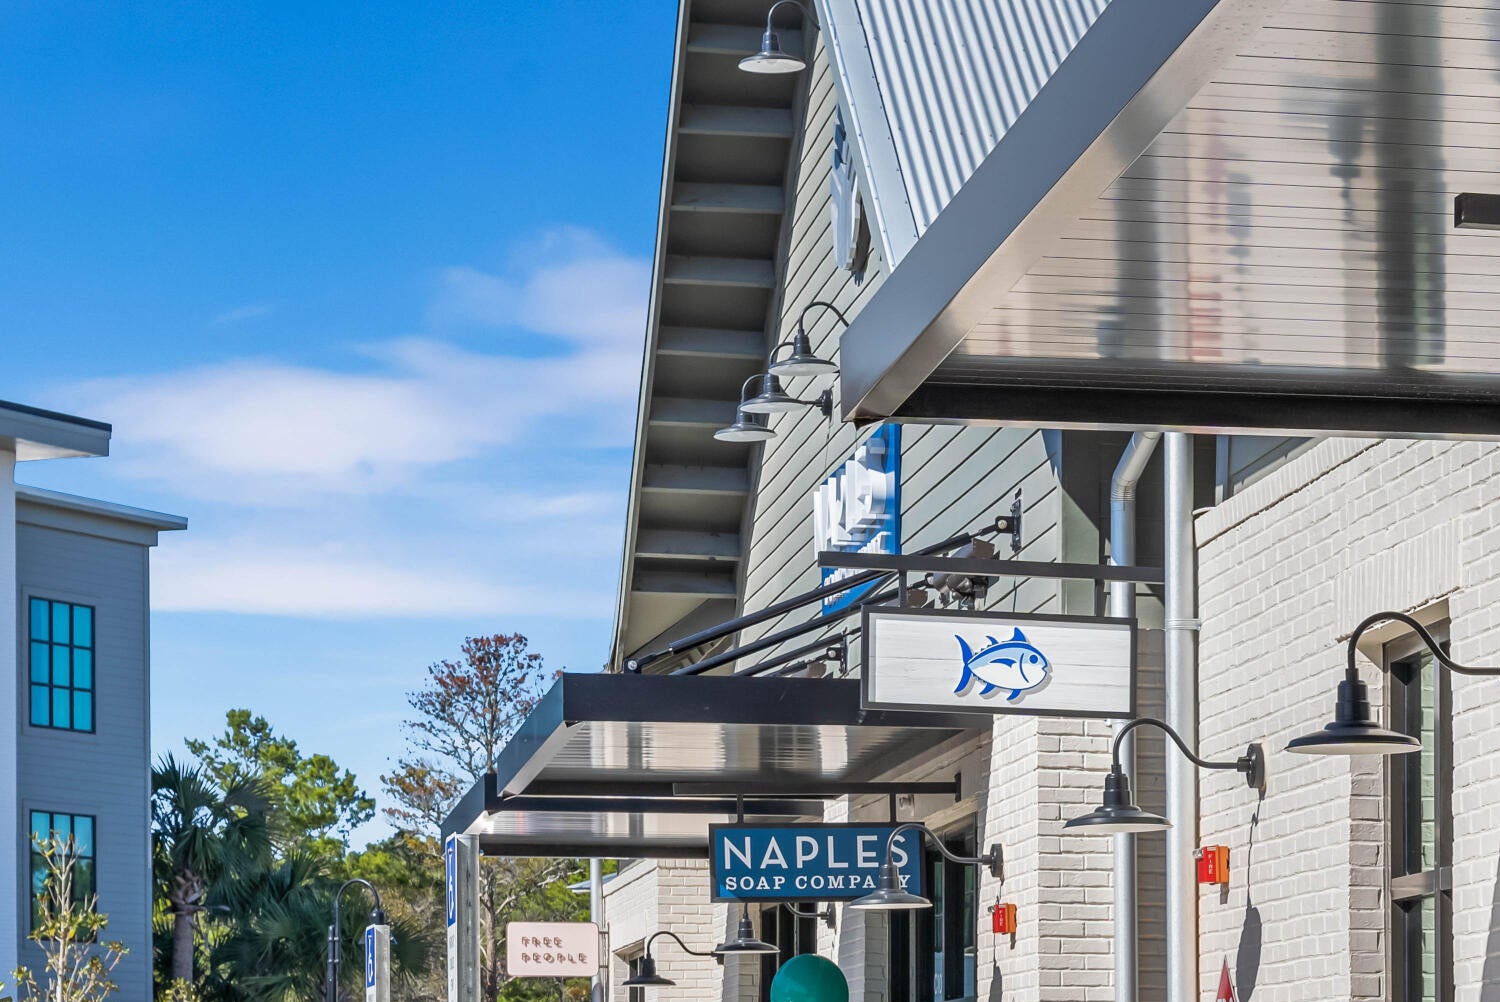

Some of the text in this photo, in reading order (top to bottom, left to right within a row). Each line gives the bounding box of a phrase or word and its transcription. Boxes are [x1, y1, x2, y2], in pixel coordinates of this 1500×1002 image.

[724, 835, 908, 870] NAPLES
[725, 874, 911, 890] SOAP COMPAY
[522, 936, 562, 948] FREE
[522, 952, 588, 964] PEOPLE
